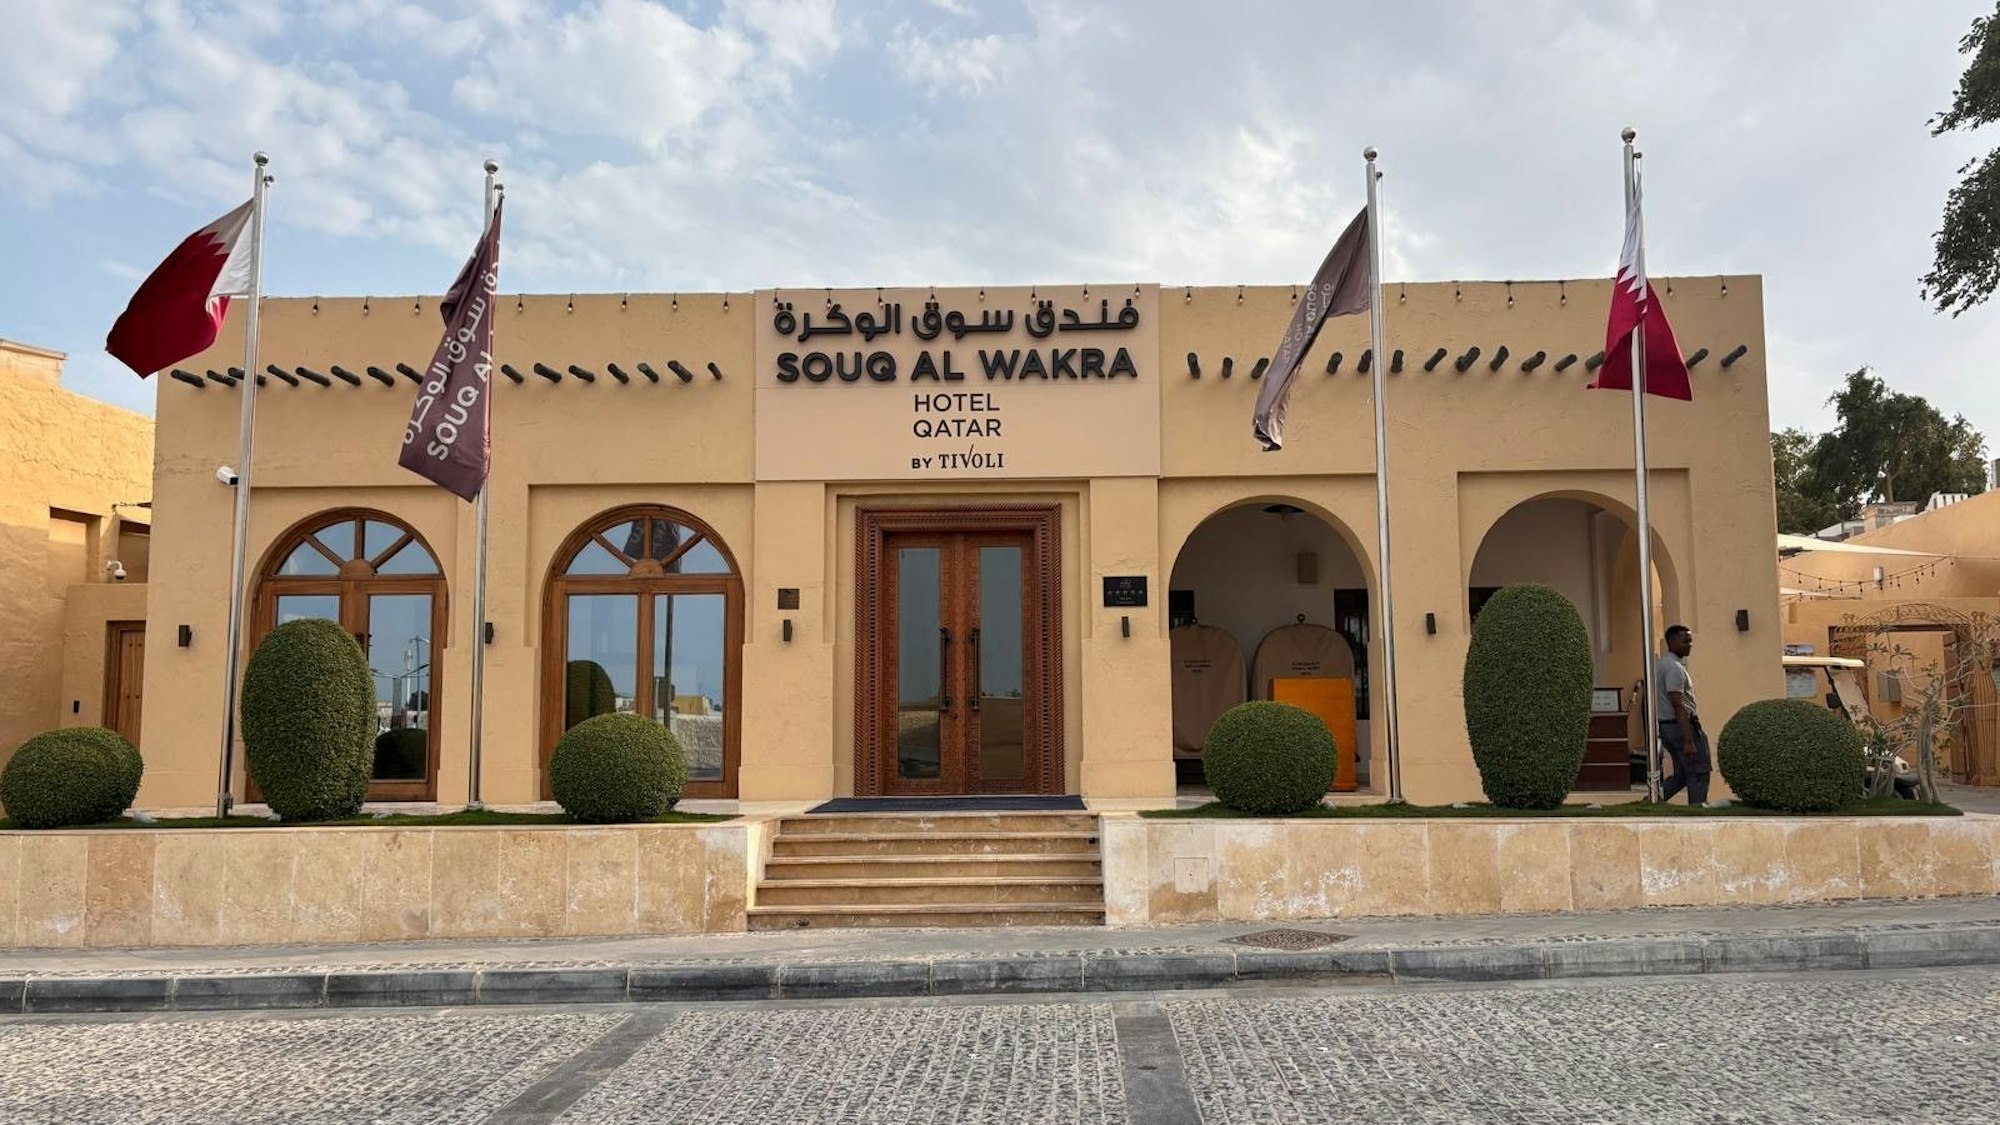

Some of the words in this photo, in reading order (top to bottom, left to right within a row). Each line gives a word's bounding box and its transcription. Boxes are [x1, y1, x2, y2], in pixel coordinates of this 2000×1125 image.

[444, 296, 486, 364] سوق
[774, 302, 901, 342] الوكرة
[912, 302, 1014, 341] سوق
[1025, 298, 1140, 338] فندق
[777, 351, 897, 382] SOUQ
[911, 350, 965, 381] AL
[979, 347, 1138, 380] WAKRA
[914, 393, 1000, 412] HOTEL
[426, 385, 479, 461] SOUQ
[913, 418, 1002, 438] QATAR
[911, 458, 932, 469] BY
[938, 444, 1005, 469] TIVOLI
